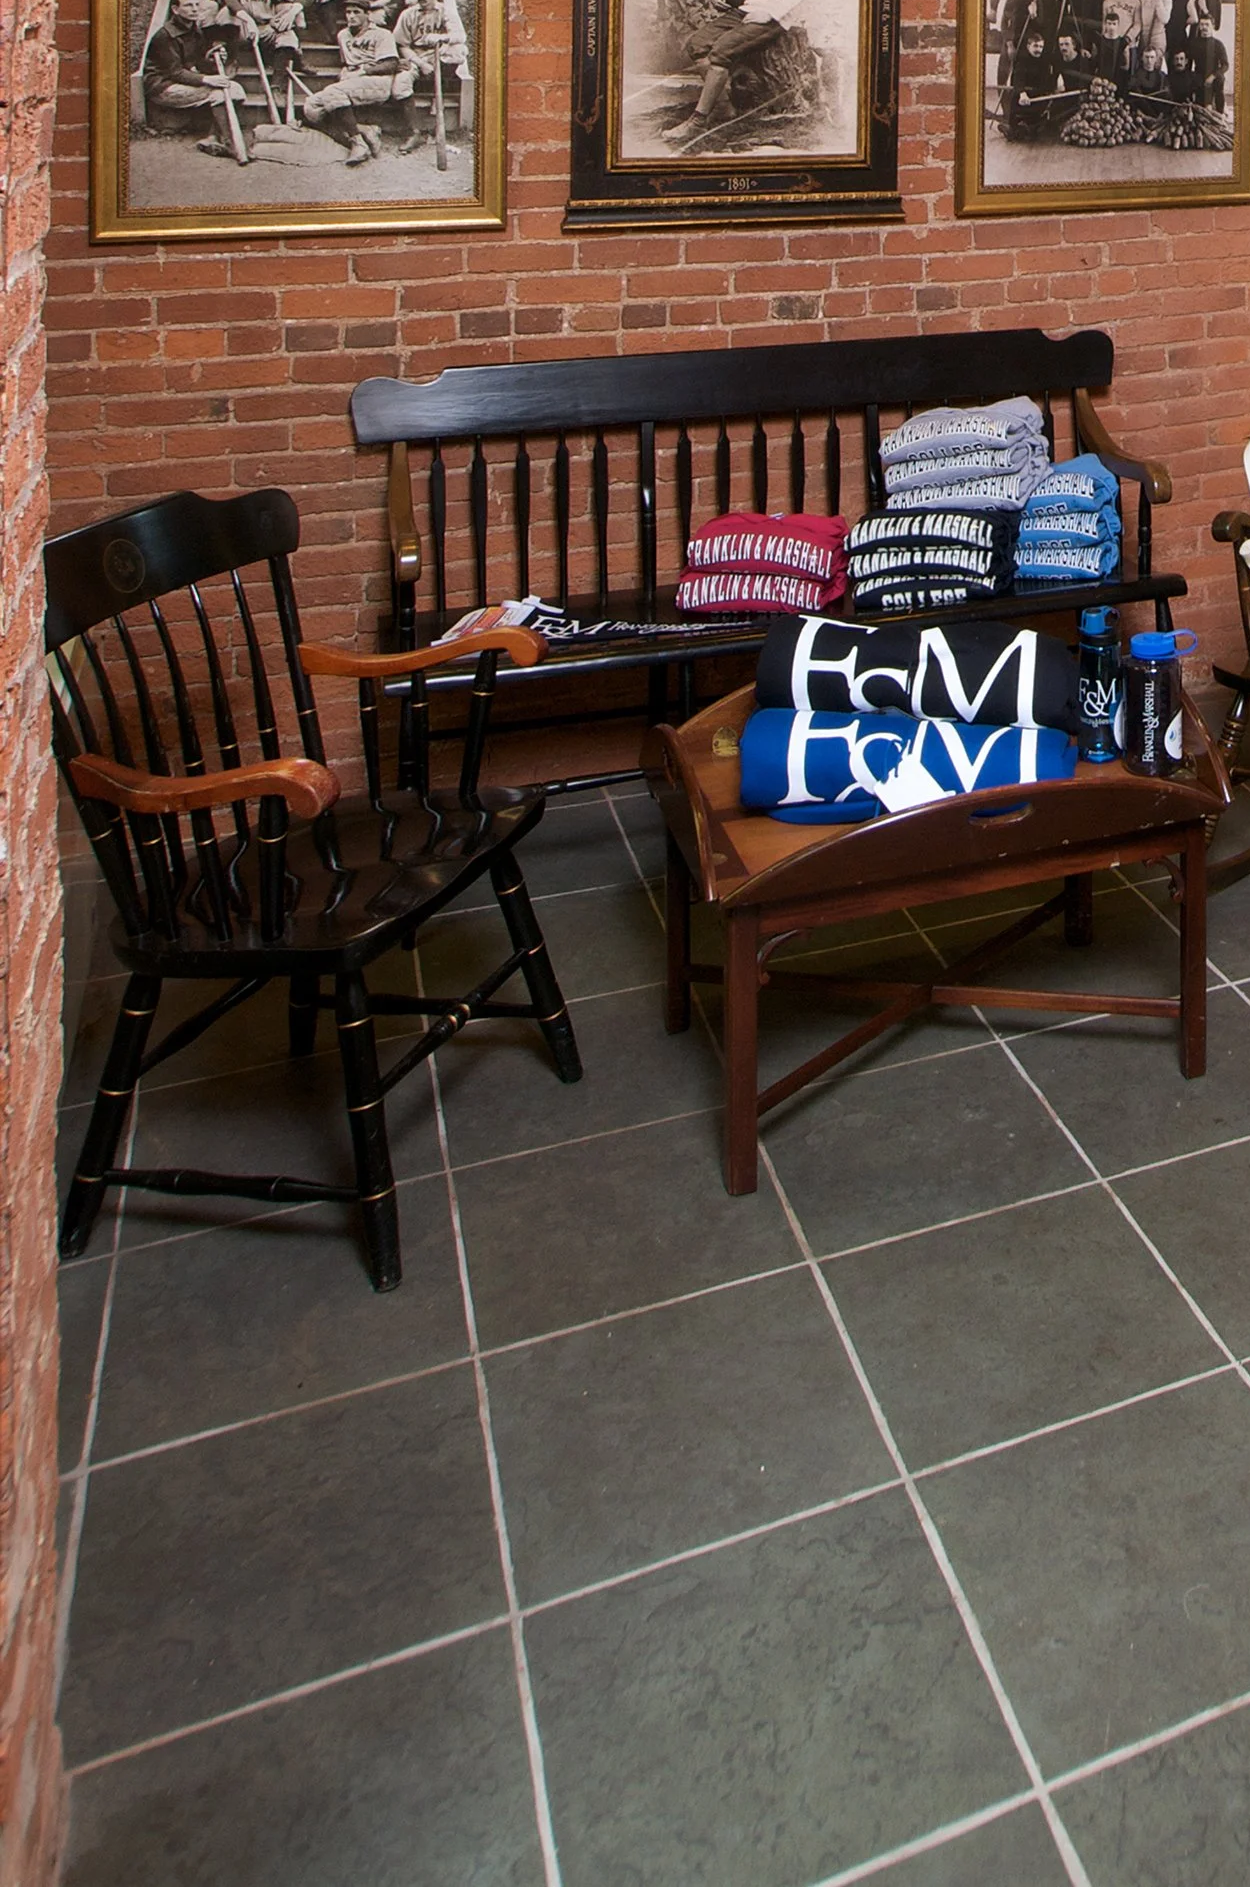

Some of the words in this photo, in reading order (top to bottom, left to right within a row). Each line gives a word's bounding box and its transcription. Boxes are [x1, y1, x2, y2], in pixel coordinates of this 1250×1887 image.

[587, 16, 596, 57] CAPTAIN
[727, 177, 750, 191] 1891
[911, 516, 922, 536] &
[922, 514, 993, 549] MARSHALL
[754, 534, 764, 560] &
[764, 535, 833, 579] MARSHALL
[741, 574, 751, 599] &
[1079, 677, 1117, 717] F&M
